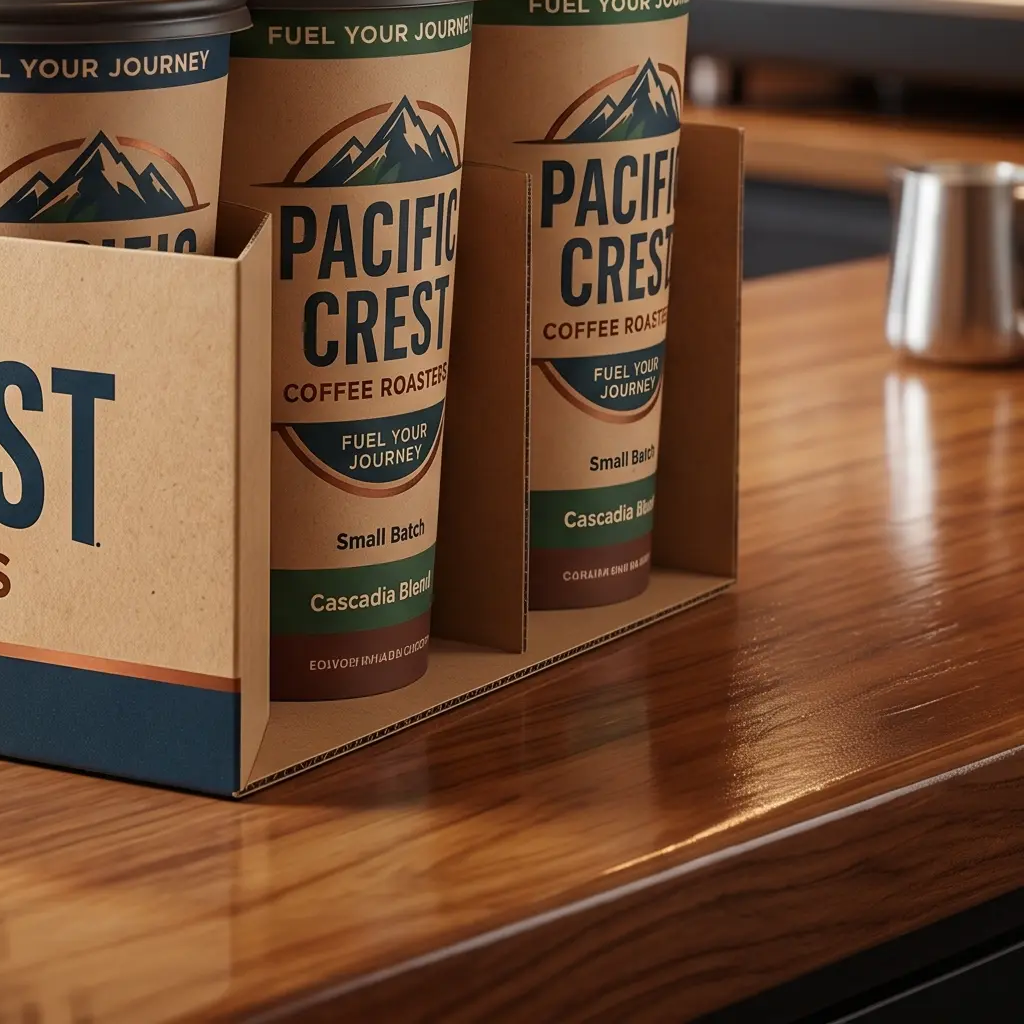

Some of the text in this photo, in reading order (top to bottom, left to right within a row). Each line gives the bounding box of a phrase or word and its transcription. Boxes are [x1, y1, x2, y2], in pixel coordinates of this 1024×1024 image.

[268, 26, 336, 46] FUEL
[344, 24, 408, 45] YOUR
[19, 58, 99, 79] YOUR
[108, 49, 210, 78] JOURNEY
[540, 146, 678, 229] PACIFI
[280, 187, 458, 281] PACIFIC
[302, 274, 450, 368] CREST
[542, 305, 668, 341] COFFEE ROASTE
[282, 361, 448, 404] COFFEE ROASTERS
[594, 356, 659, 383] FUEL YOUR
[600, 376, 656, 400] JOURNEY
[341, 422, 428, 451] FUEL YOUR
[348, 444, 423, 471] JOURNEY
[589, 450, 629, 472] Small
[563, 504, 634, 529] Cascadia
[336, 518, 425, 551] Small Batch
[310, 569, 432, 613] Cascadia Blend
